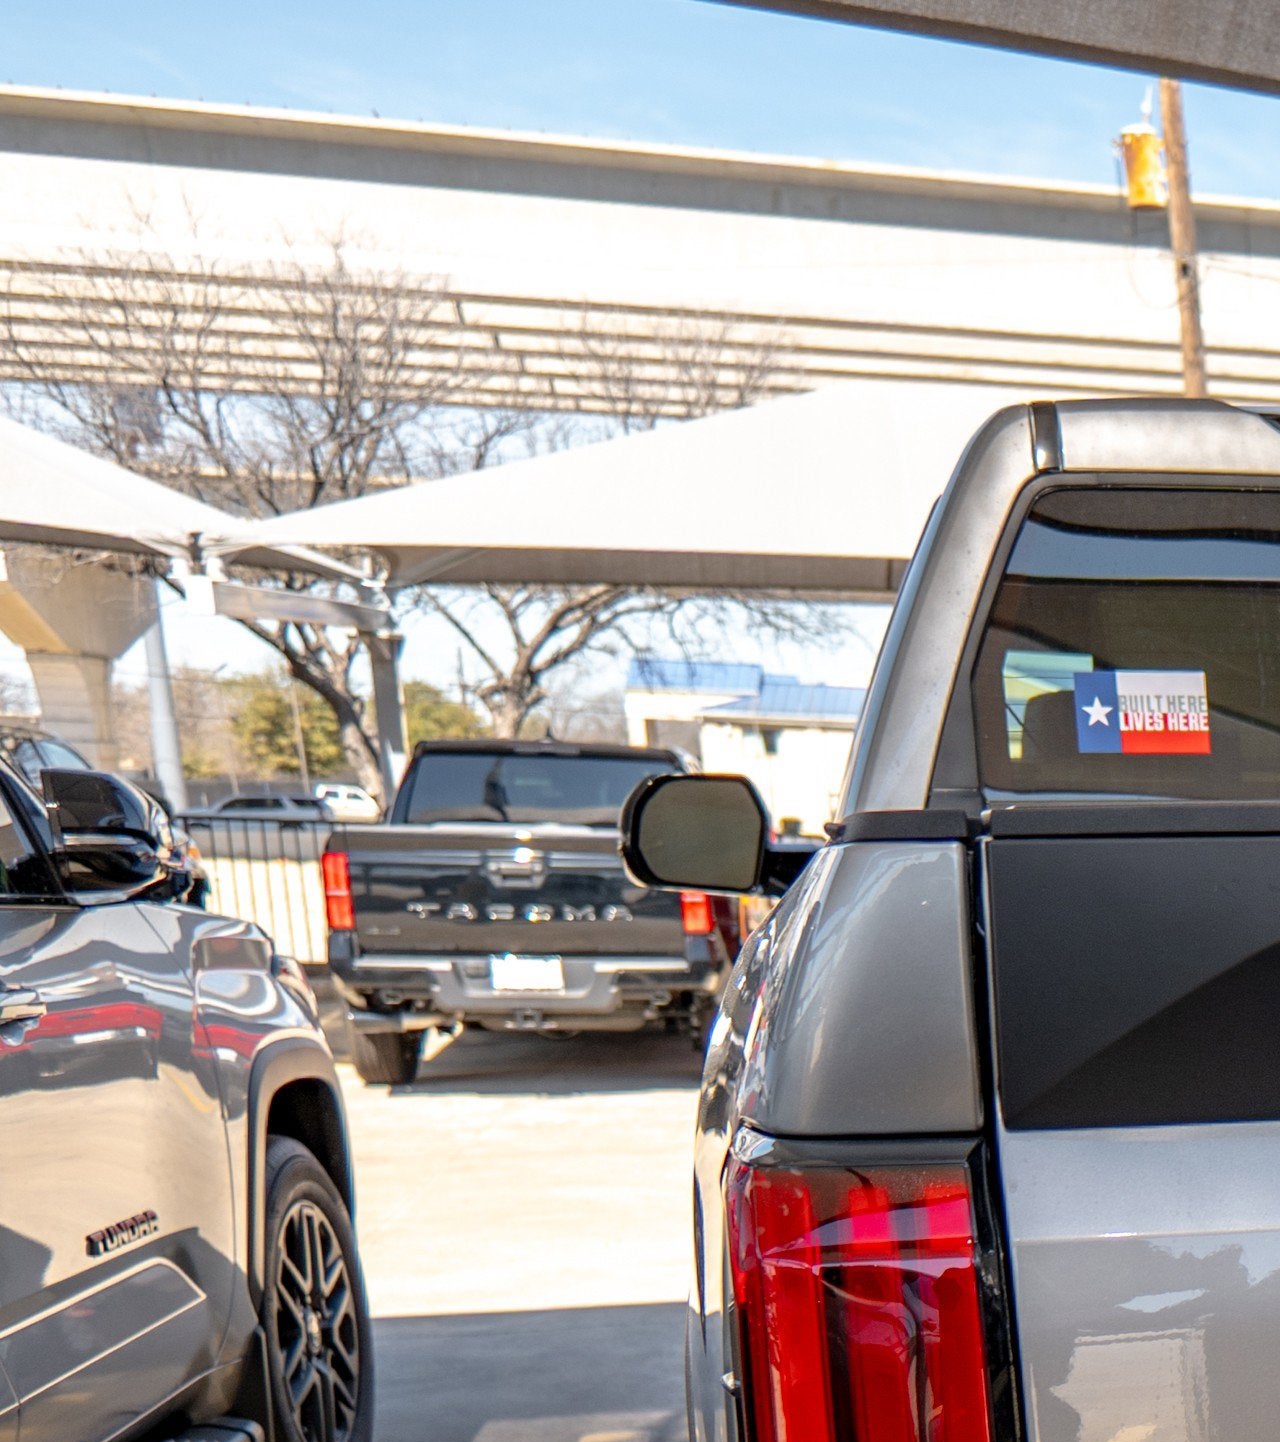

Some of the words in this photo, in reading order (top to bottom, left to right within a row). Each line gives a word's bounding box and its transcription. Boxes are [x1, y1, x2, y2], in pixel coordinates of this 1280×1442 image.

[1119, 695, 1162, 713] BUILT
[1166, 694, 1206, 713] HERE
[1119, 713, 1164, 731] LIVES
[1167, 713, 1209, 731] HERE
